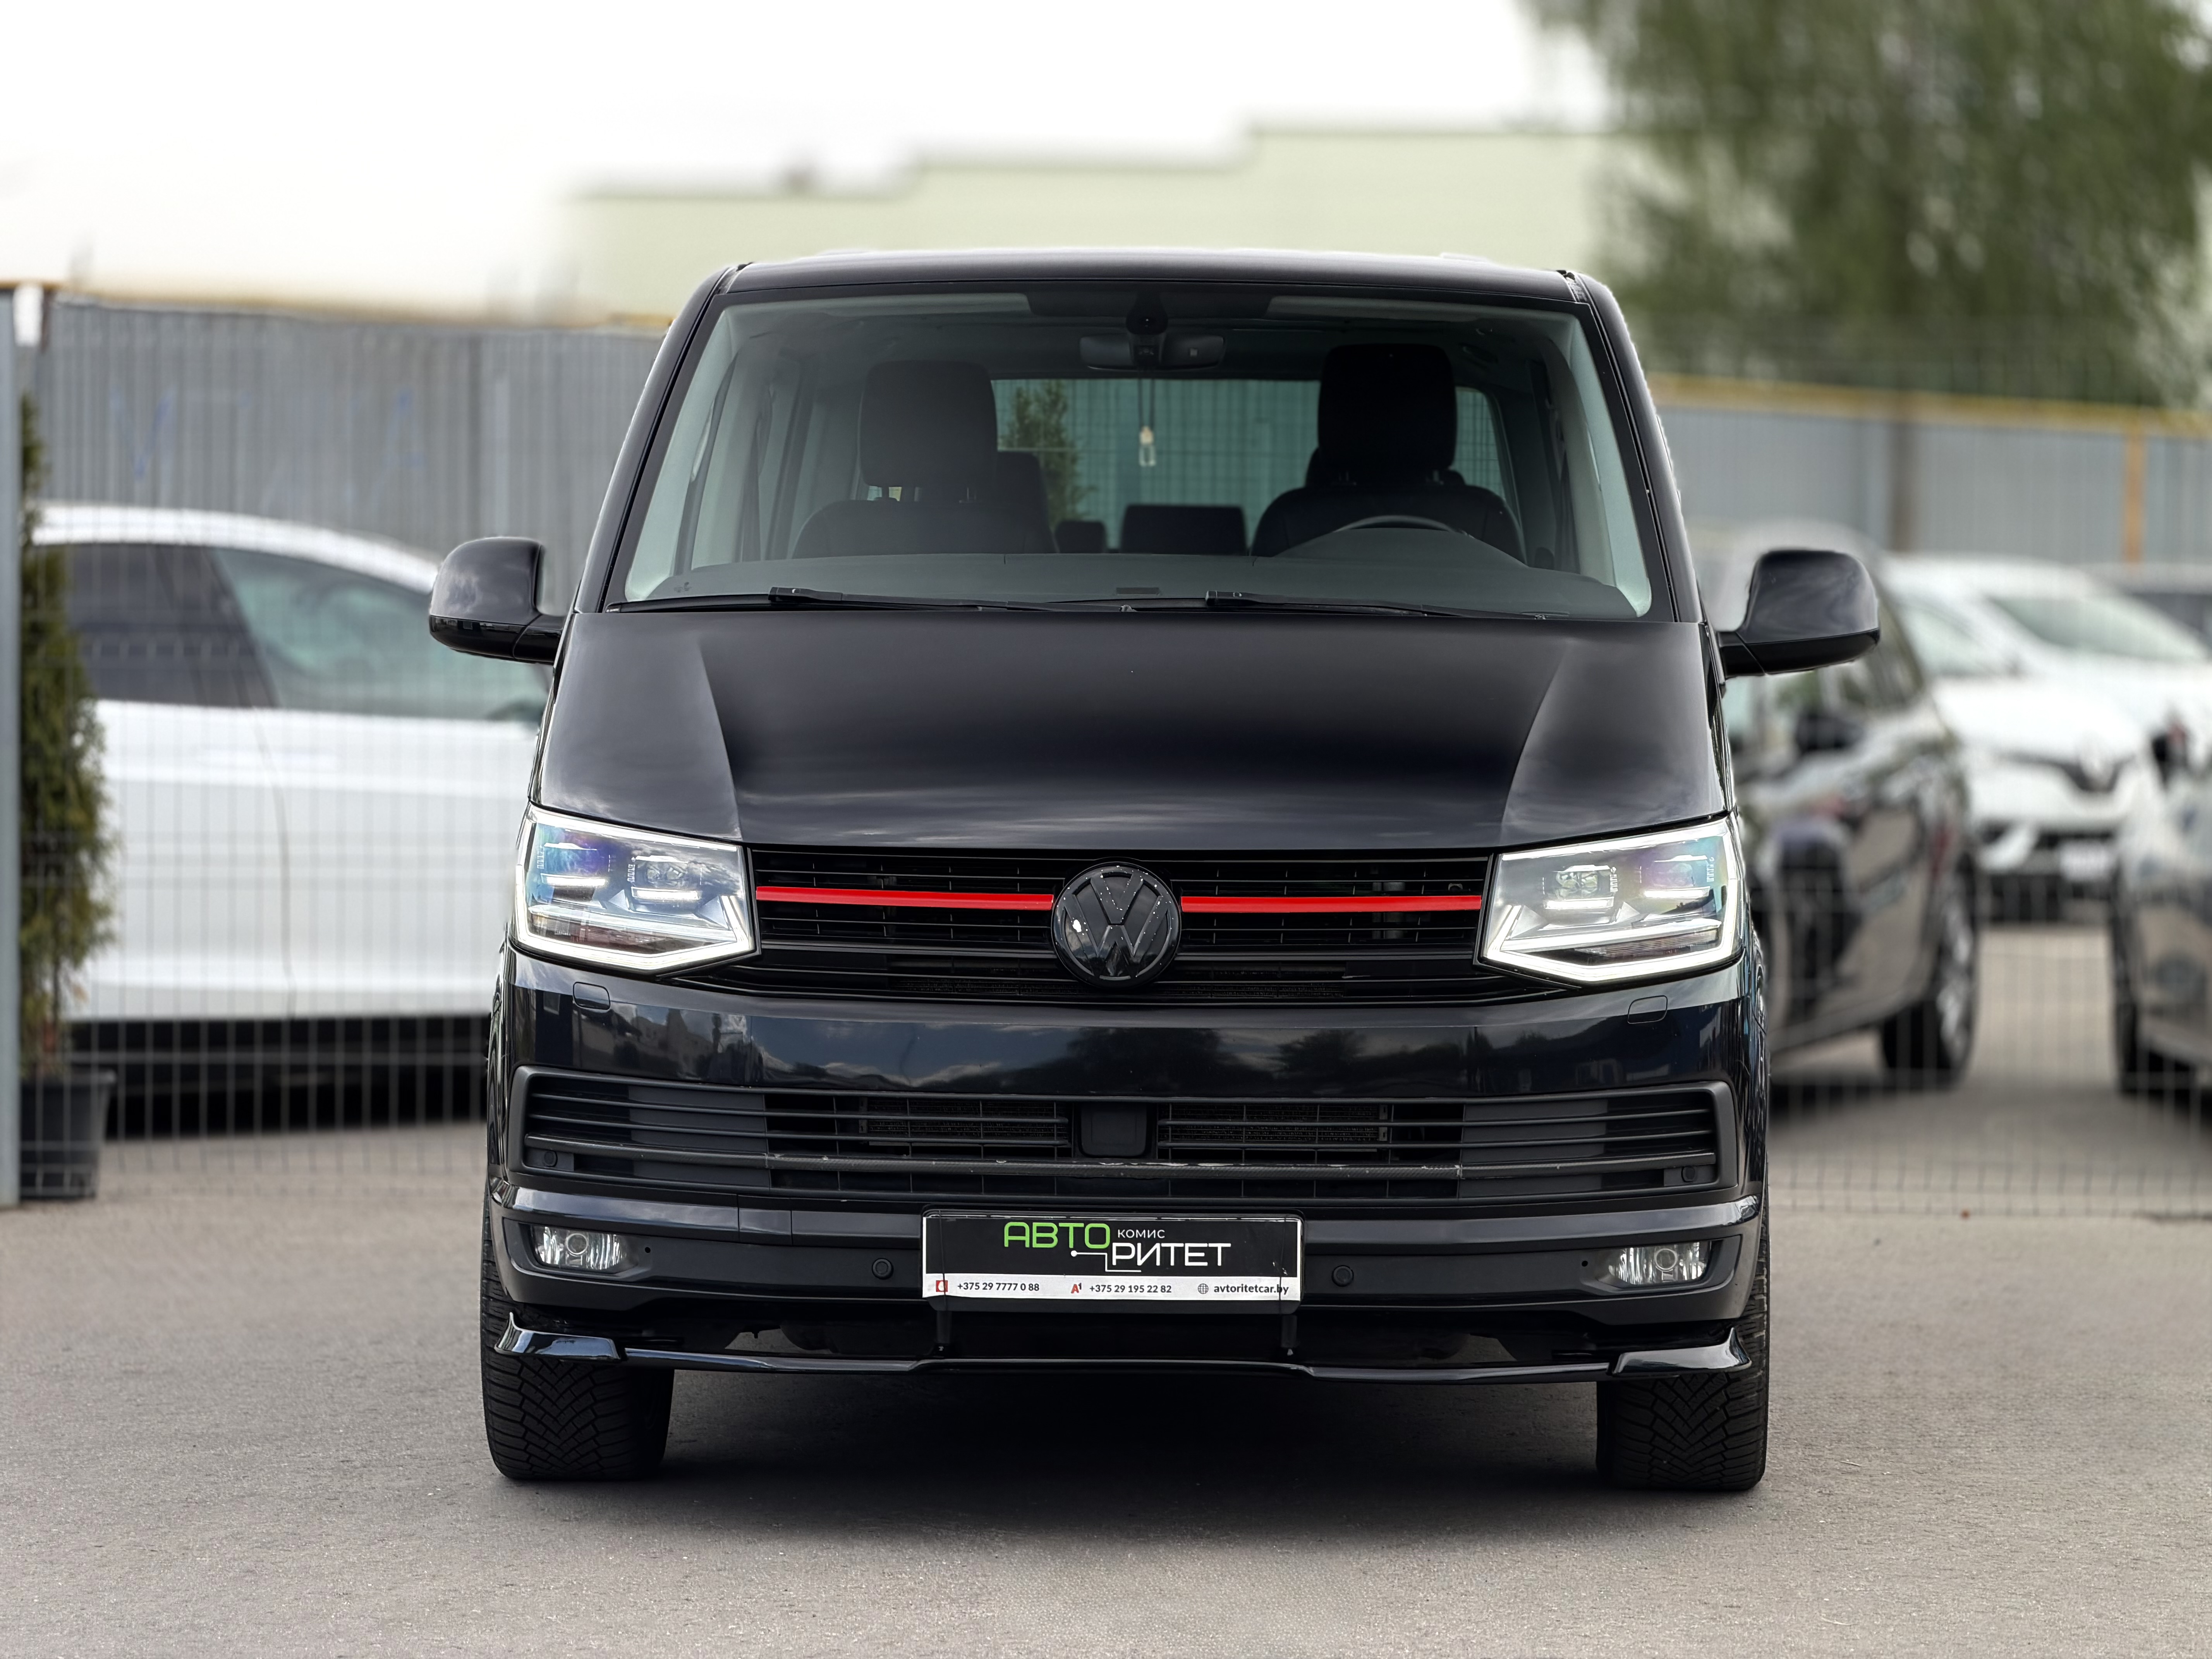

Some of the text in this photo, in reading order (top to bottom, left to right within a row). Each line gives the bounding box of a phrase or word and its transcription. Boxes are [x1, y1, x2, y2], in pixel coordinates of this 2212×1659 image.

[1059, 869, 1173, 982] VW
[1004, 1221, 1110, 1249] АВТО
[1118, 1229, 1165, 1238] КОМИС
[1112, 1242, 1231, 1266] РИТЕТ
[996, 1283, 1018, 1291] 7777
[1214, 1283, 1289, 1295] avtoritetcar.by
